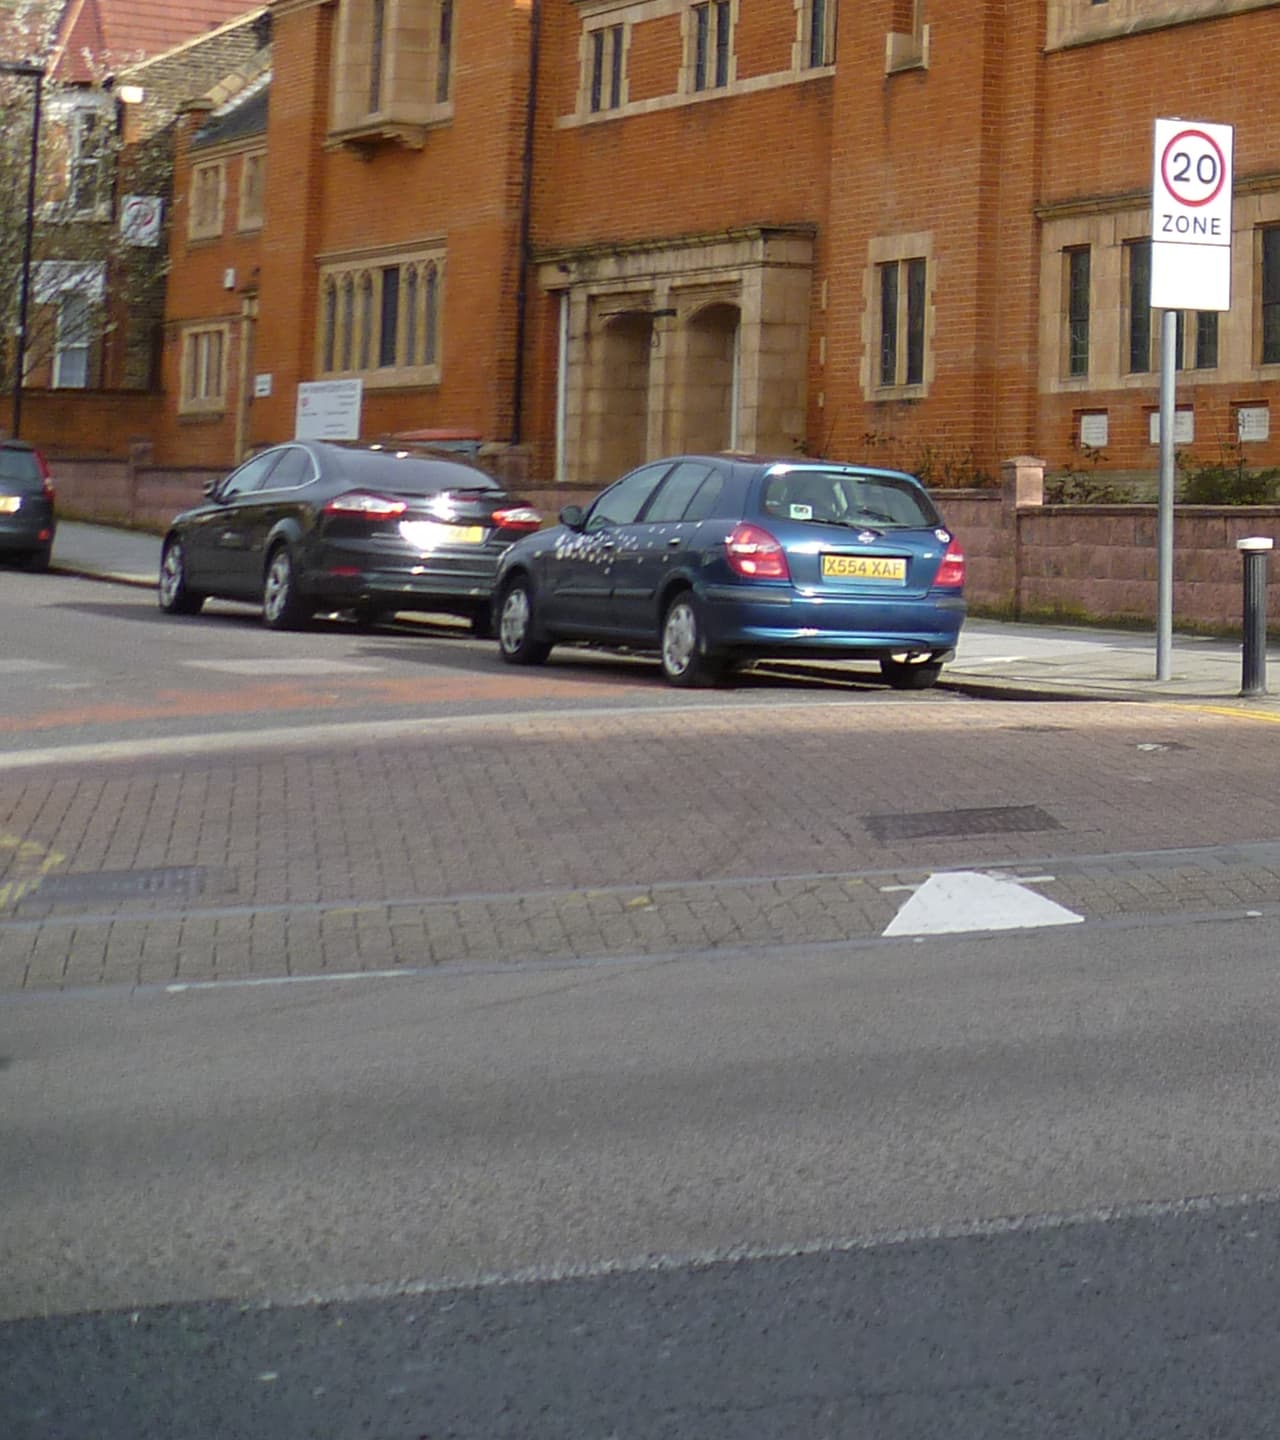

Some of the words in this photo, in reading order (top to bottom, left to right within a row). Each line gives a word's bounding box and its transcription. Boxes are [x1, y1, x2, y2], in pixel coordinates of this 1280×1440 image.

[1172, 152, 1217, 185] 20
[1162, 214, 1221, 236] ZONE
[826, 557, 867, 573] X554
[872, 559, 902, 576] XAF
